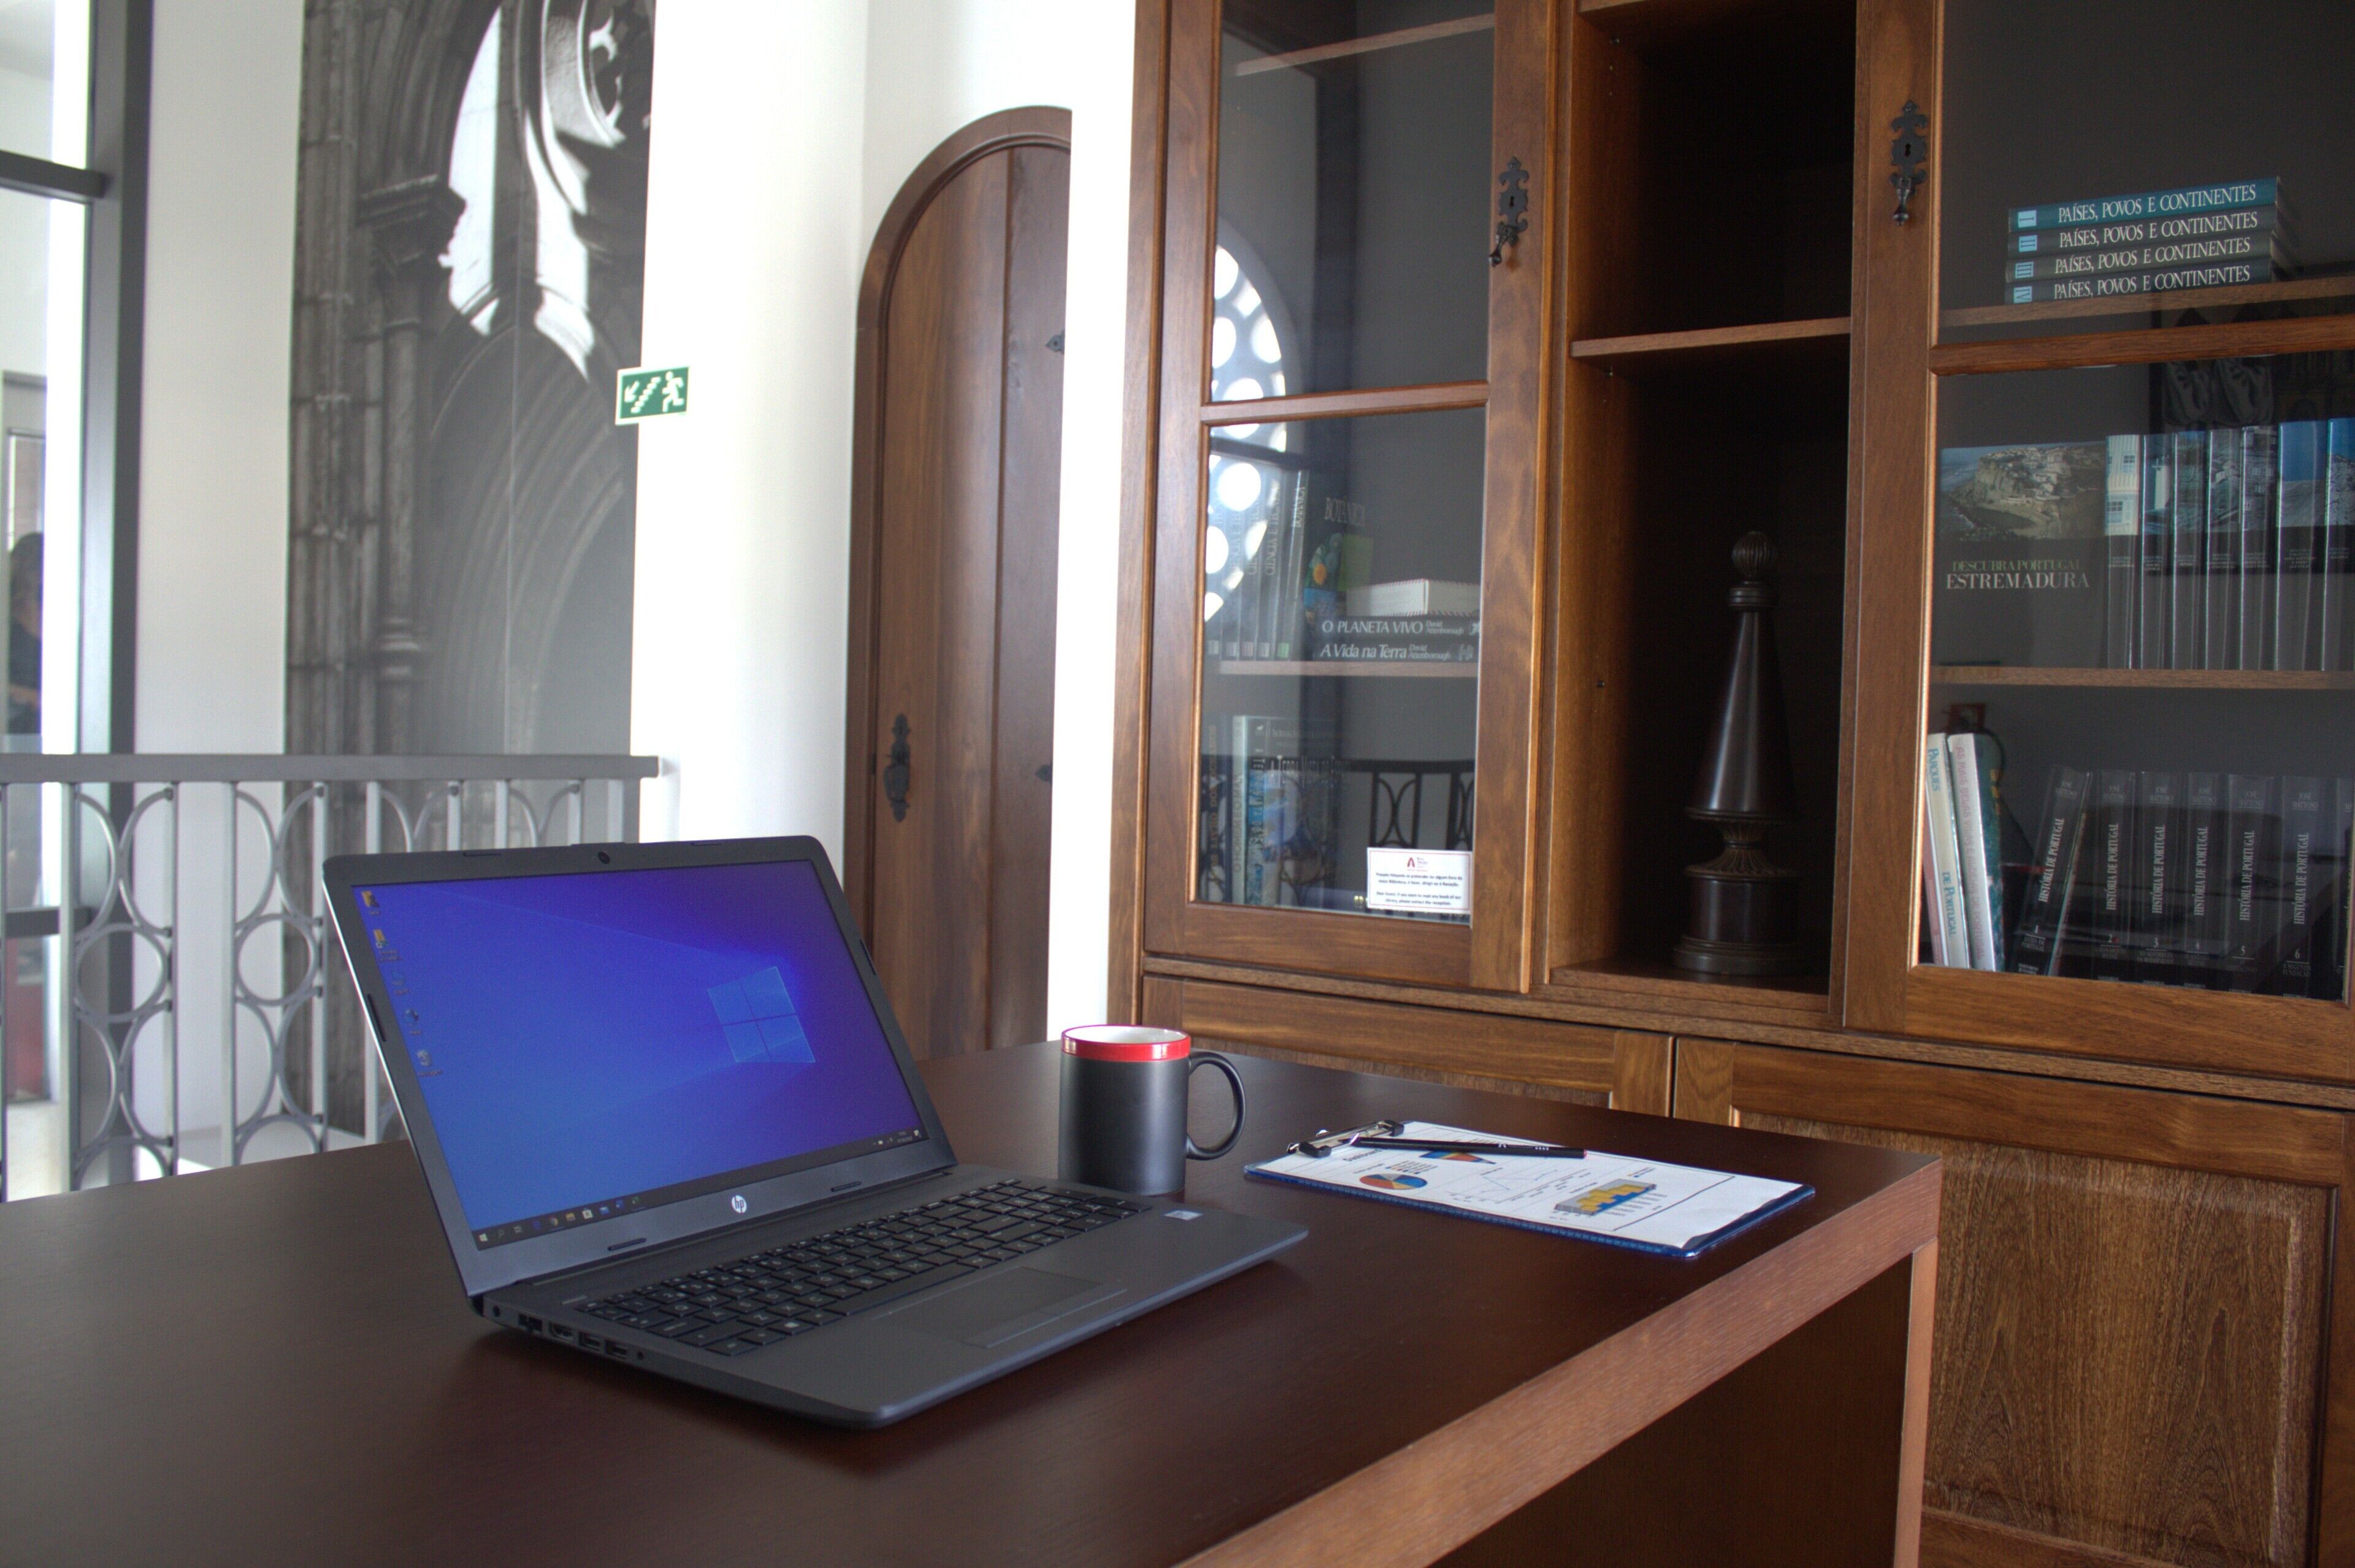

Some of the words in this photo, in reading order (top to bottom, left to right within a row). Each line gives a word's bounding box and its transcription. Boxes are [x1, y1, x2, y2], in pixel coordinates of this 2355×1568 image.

[2058, 202, 2098, 223] PAÍSES,
[2102, 198, 2142, 218] POVOS
[2148, 197, 2156, 212] E
[2159, 184, 2256, 212] CONTINENTES
[2059, 228, 2099, 248] PAÍSES,
[2103, 224, 2143, 243] POVOS
[2150, 223, 2158, 239] E
[2161, 212, 2258, 237] CONTINENTES
[2054, 253, 2094, 274] PAÍSES,
[2097, 250, 2138, 270] POVOS
[2143, 248, 2151, 264] E
[2154, 237, 2251, 264] CONTINENTES
[2053, 279, 2094, 300] PAÍSES,
[2097, 276, 2137, 296] POVOS
[2142, 275, 2151, 291] E
[2154, 265, 2250, 291] CONTINENTES
[1946, 572, 2090, 590] ESTREMADURA
[1953, 559, 2014, 572] DESCUBRA
[2015, 559, 2085, 572] PORTUGAL
[1322, 621, 1334, 634] O
[1337, 620, 1390, 635] PLANETA
[1393, 620, 1423, 634] VIVO
[1320, 644, 1331, 657] A
[1334, 643, 1360, 657] Vida
[1361, 647, 1376, 658] na
[1378, 644, 1407, 659] Terra
[1928, 748, 1941, 792] PARQUES
[2050, 818, 2065, 854] PORTUGAL
[2108, 823, 2119, 862] PORTUGAL
[2153, 825, 2165, 864] PORTUGAL
[2196, 827, 2208, 866] PORTUGAL
[2242, 830, 2255, 871] PORTUGAL
[2296, 833, 2309, 873] PORTUGAL
[1942, 871, 1951, 885] DE
[2047, 855, 2056, 866] DE
[2108, 863, 2117, 874] DE
[2153, 866, 2163, 878] DE
[2196, 868, 2206, 879] DE
[2037, 866, 2053, 903] HISTÓRIA
[2105, 875, 2117, 911] HISTÓRIA
[2150, 878, 2163, 914] HISTÓRIA
[2242, 873, 2253, 885] DE
[2296, 875, 2307, 887] DE
[1944, 886, 1958, 938] PORTUGAL
[2192, 881, 2205, 916] HISTÓRIA
[2238, 885, 2253, 921] HISTÓRIA
[2292, 888, 2306, 925] HISTÓRIA
